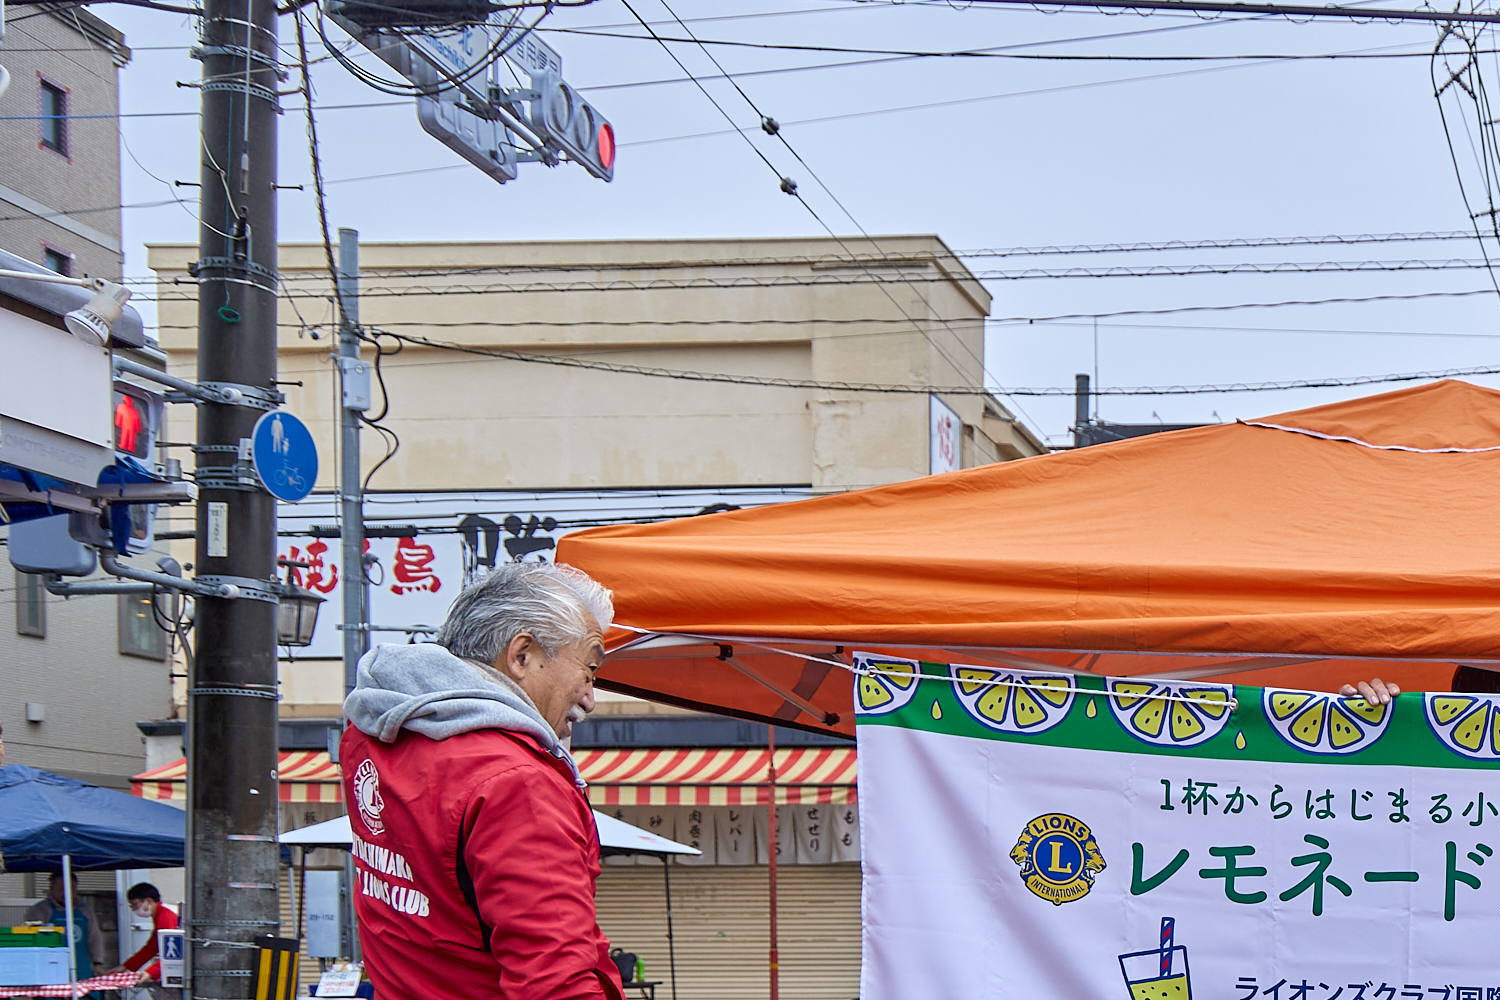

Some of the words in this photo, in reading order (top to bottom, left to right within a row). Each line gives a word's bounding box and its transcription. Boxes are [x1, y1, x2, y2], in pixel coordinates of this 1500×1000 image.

[729, 810, 742, 852] レバー
[807, 808, 820, 852] せせり
[842, 810, 854, 846] もも
[1031, 815, 1087, 839] LIONS
[1047, 841, 1072, 874] L
[391, 885, 430, 918] CLUB
[1030, 878, 1085, 898] INTERNATIONAL
